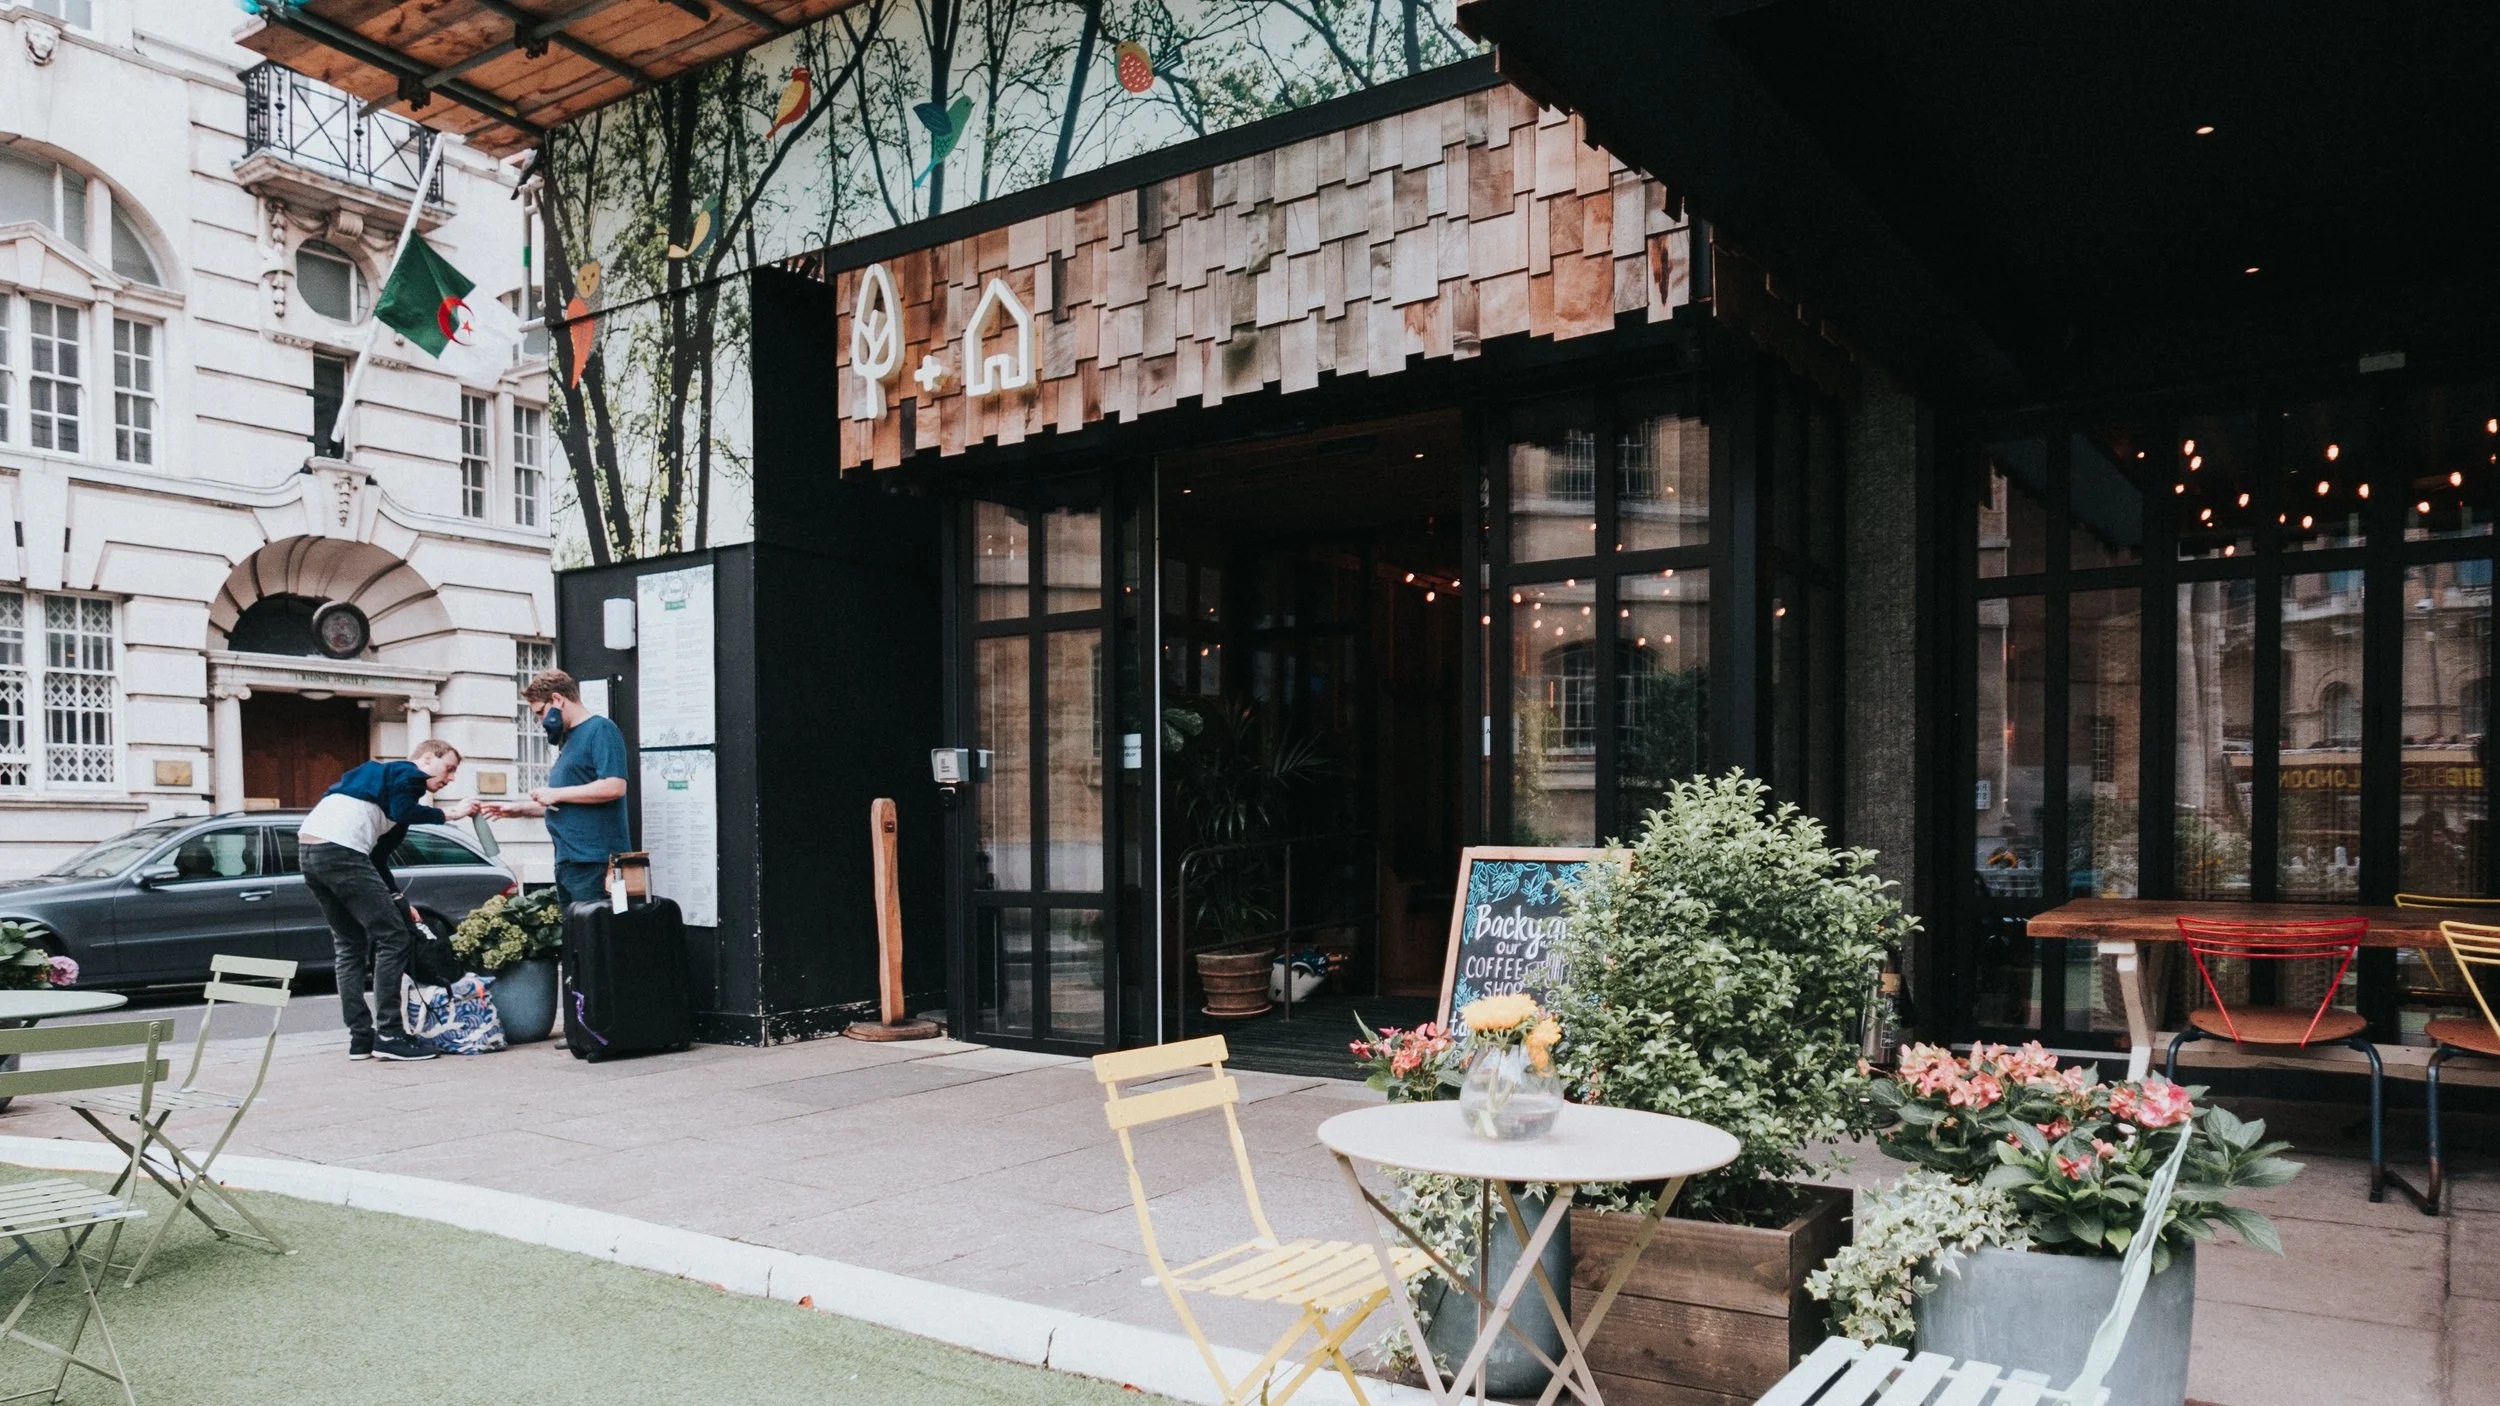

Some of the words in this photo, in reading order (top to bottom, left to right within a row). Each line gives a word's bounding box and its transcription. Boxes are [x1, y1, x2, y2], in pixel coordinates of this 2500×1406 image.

[1474, 903, 1575, 959] Backyar
[1496, 941, 1520, 955] our
[1465, 956, 1525, 981] COFFEE
